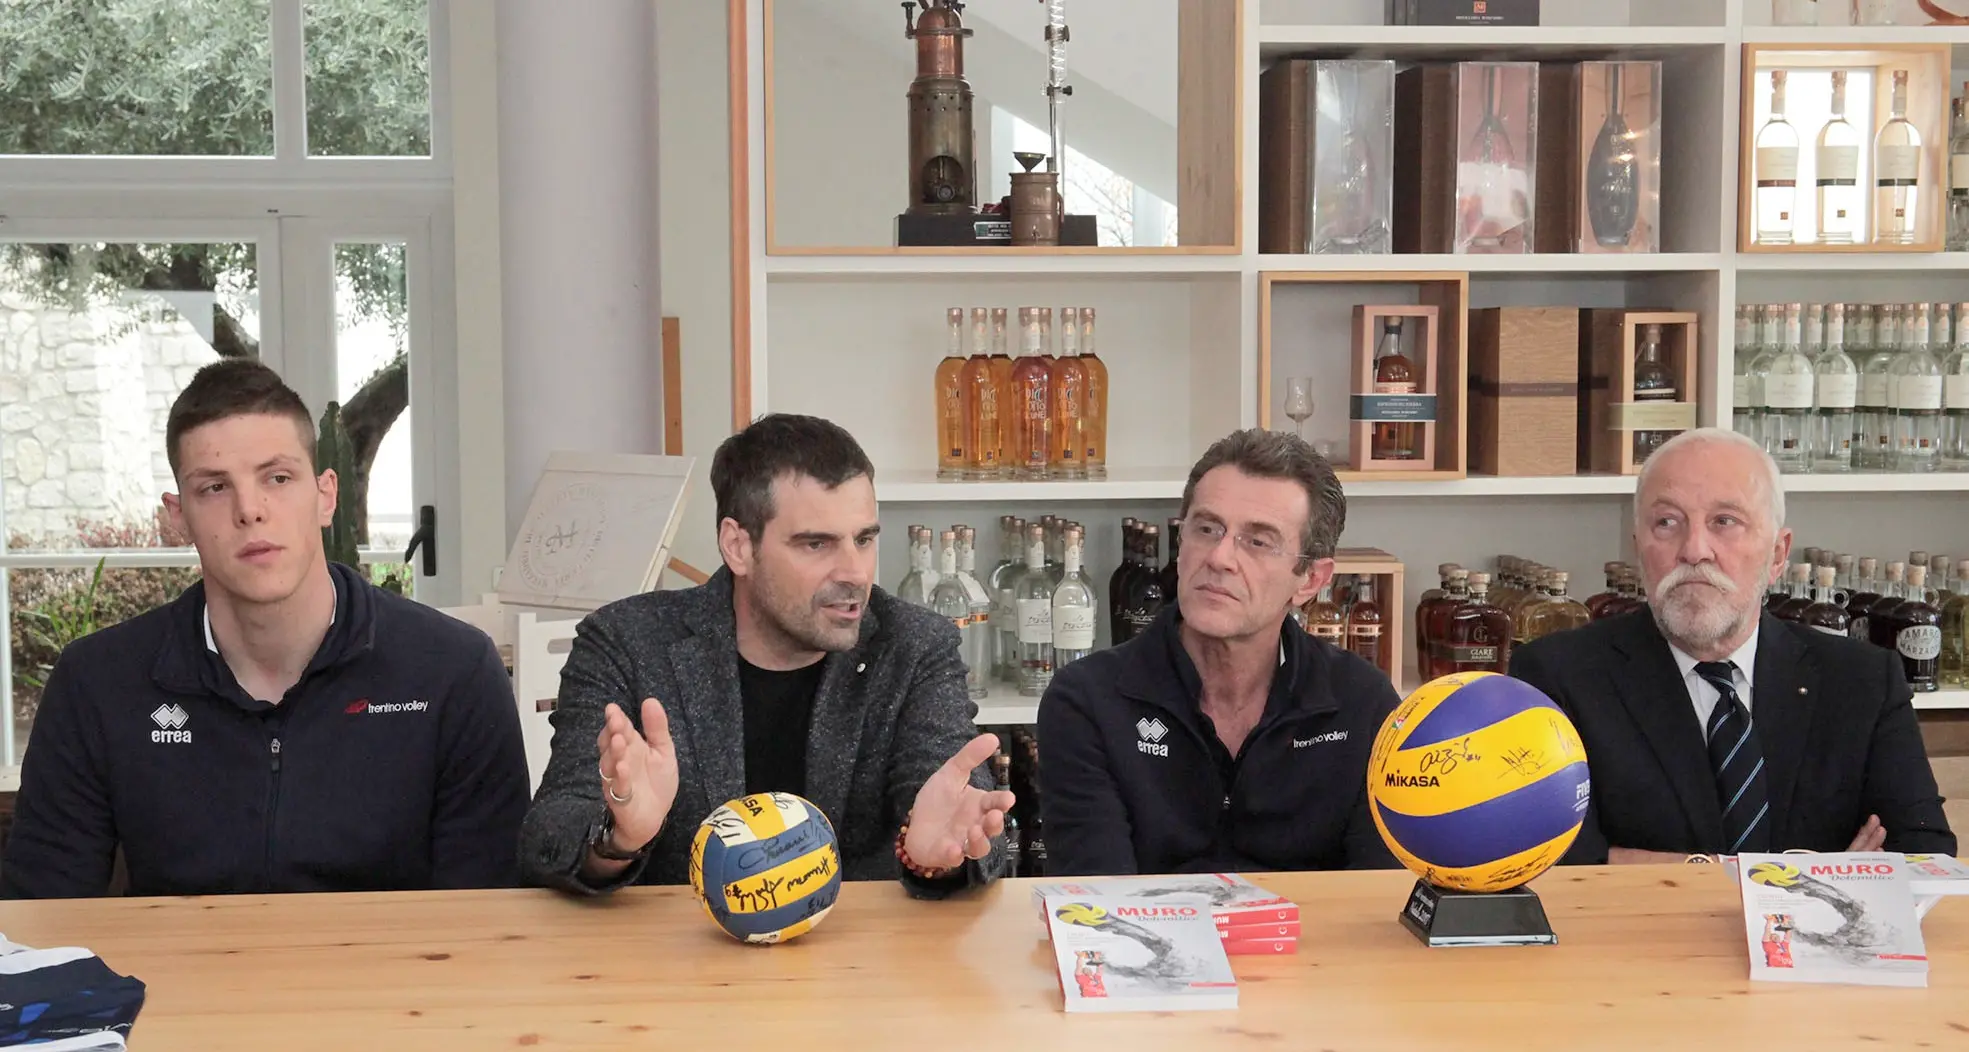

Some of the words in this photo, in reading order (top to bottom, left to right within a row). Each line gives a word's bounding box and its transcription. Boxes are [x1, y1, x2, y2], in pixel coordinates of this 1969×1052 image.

[368, 702, 401, 714] trentino
[401, 700, 429, 712] volley
[151, 729, 192, 743] errea
[1323, 730, 1349, 742] volley
[1137, 740, 1169, 757] errea
[1810, 864, 1894, 875] MURO
[1116, 907, 1198, 917] MURO
